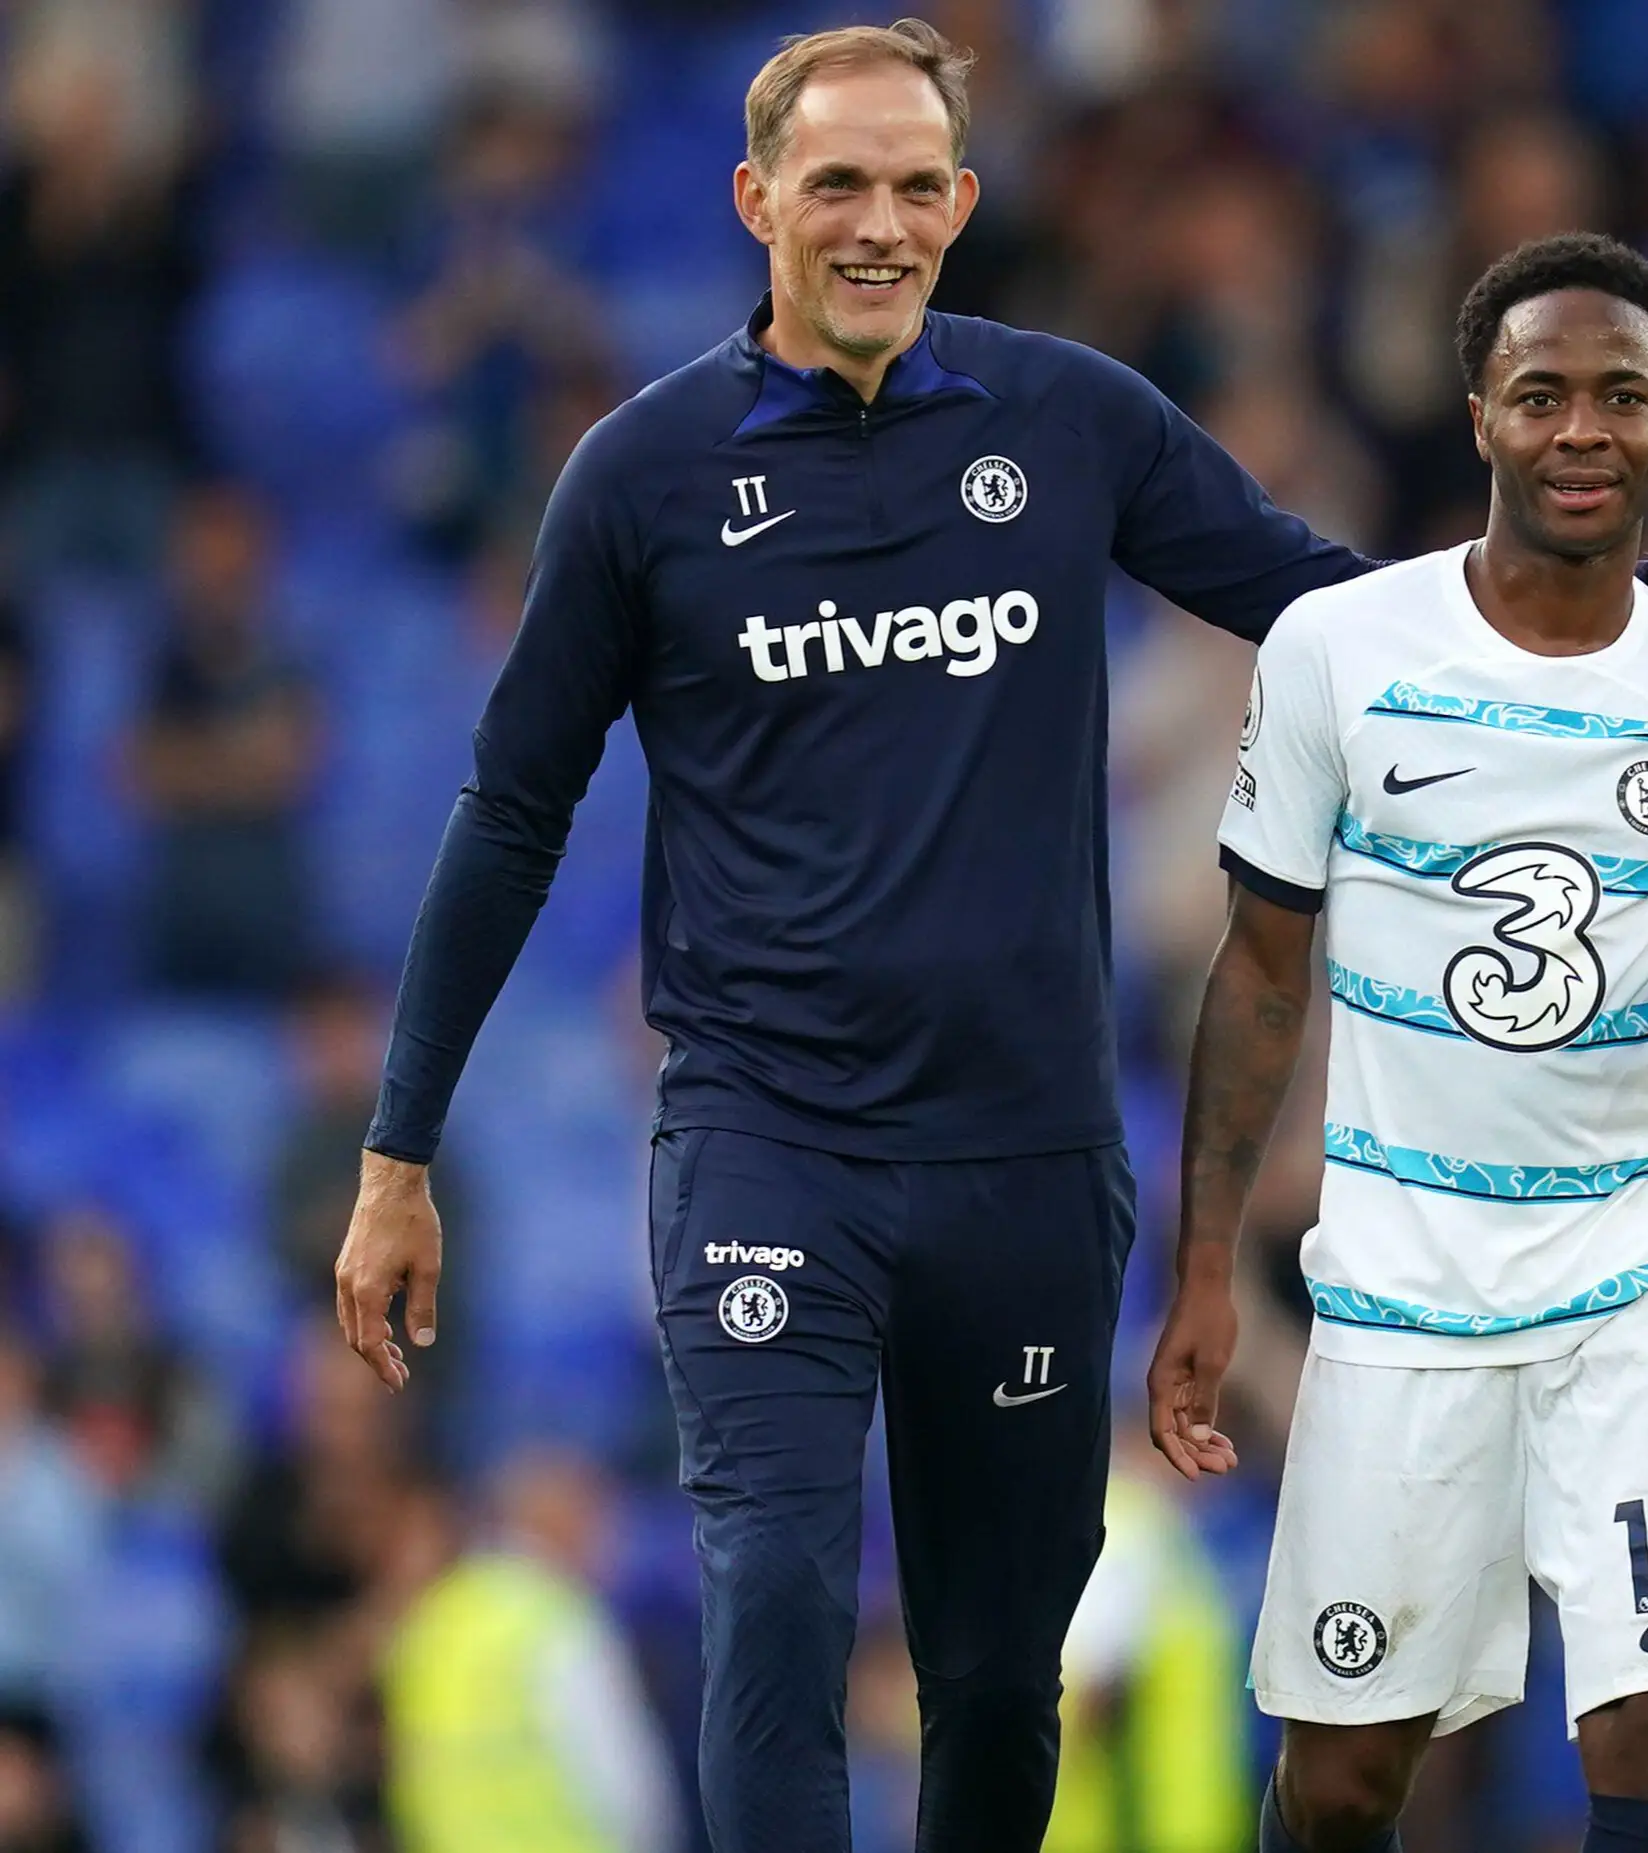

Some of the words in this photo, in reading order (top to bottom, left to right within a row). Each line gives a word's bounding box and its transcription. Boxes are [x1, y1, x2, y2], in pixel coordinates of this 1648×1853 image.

[971, 461, 1011, 476] CHELSEA
[732, 475, 768, 516] TT
[738, 590, 1039, 682] trivago
[1443, 841, 1607, 1053] 3
[704, 1240, 804, 1271] trivago
[732, 1280, 772, 1294] CHELSEA
[1023, 1346, 1055, 1385] TT
[1326, 1603, 1375, 1623] CHELSEA
